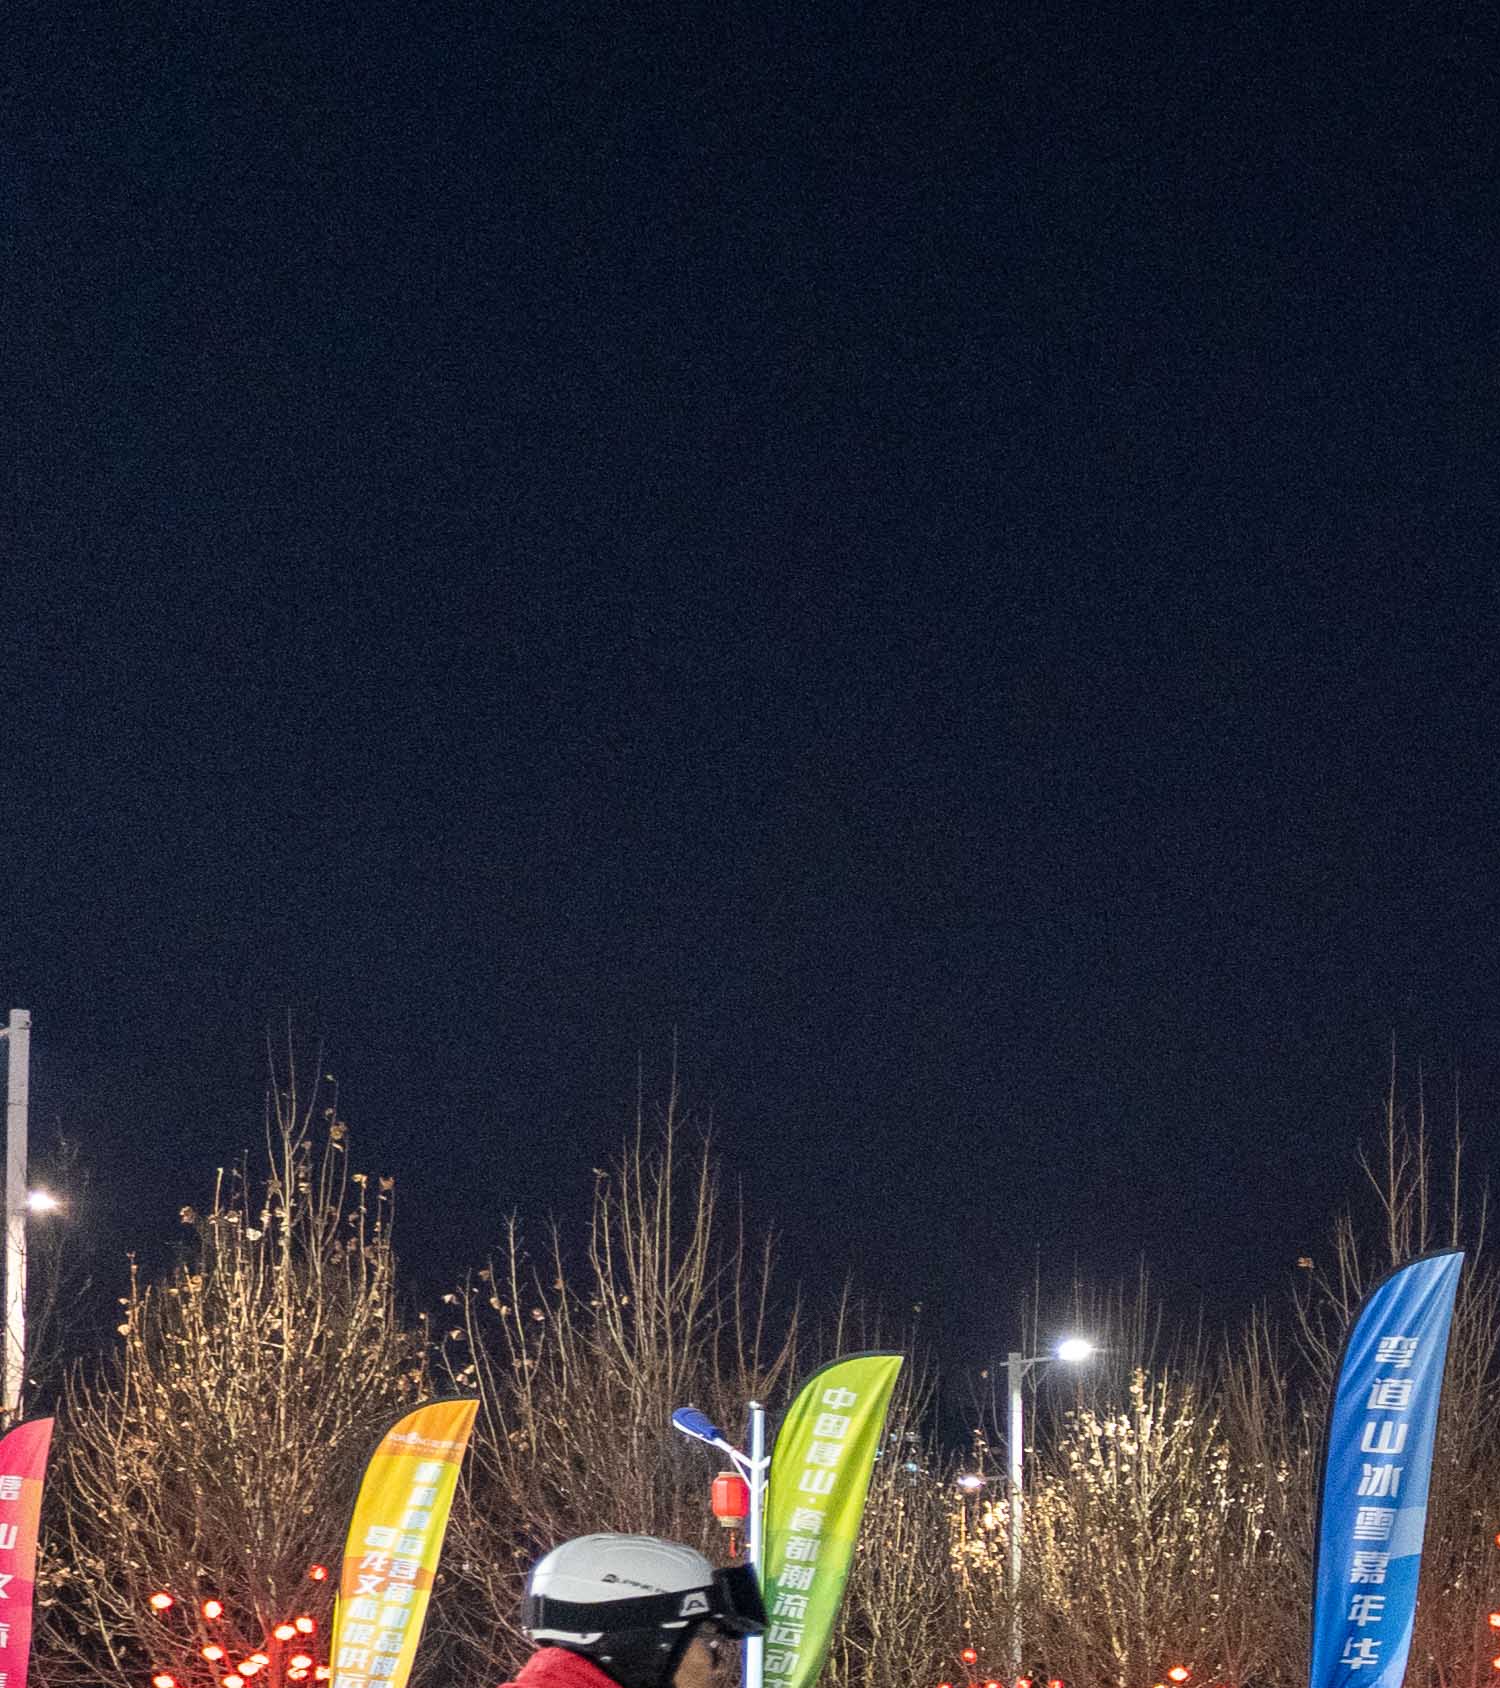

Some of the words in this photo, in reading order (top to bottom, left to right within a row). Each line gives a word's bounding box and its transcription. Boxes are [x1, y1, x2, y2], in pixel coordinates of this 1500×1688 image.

[1341, 1334, 1418, 1670] 弯道山冰雪嘉年华
